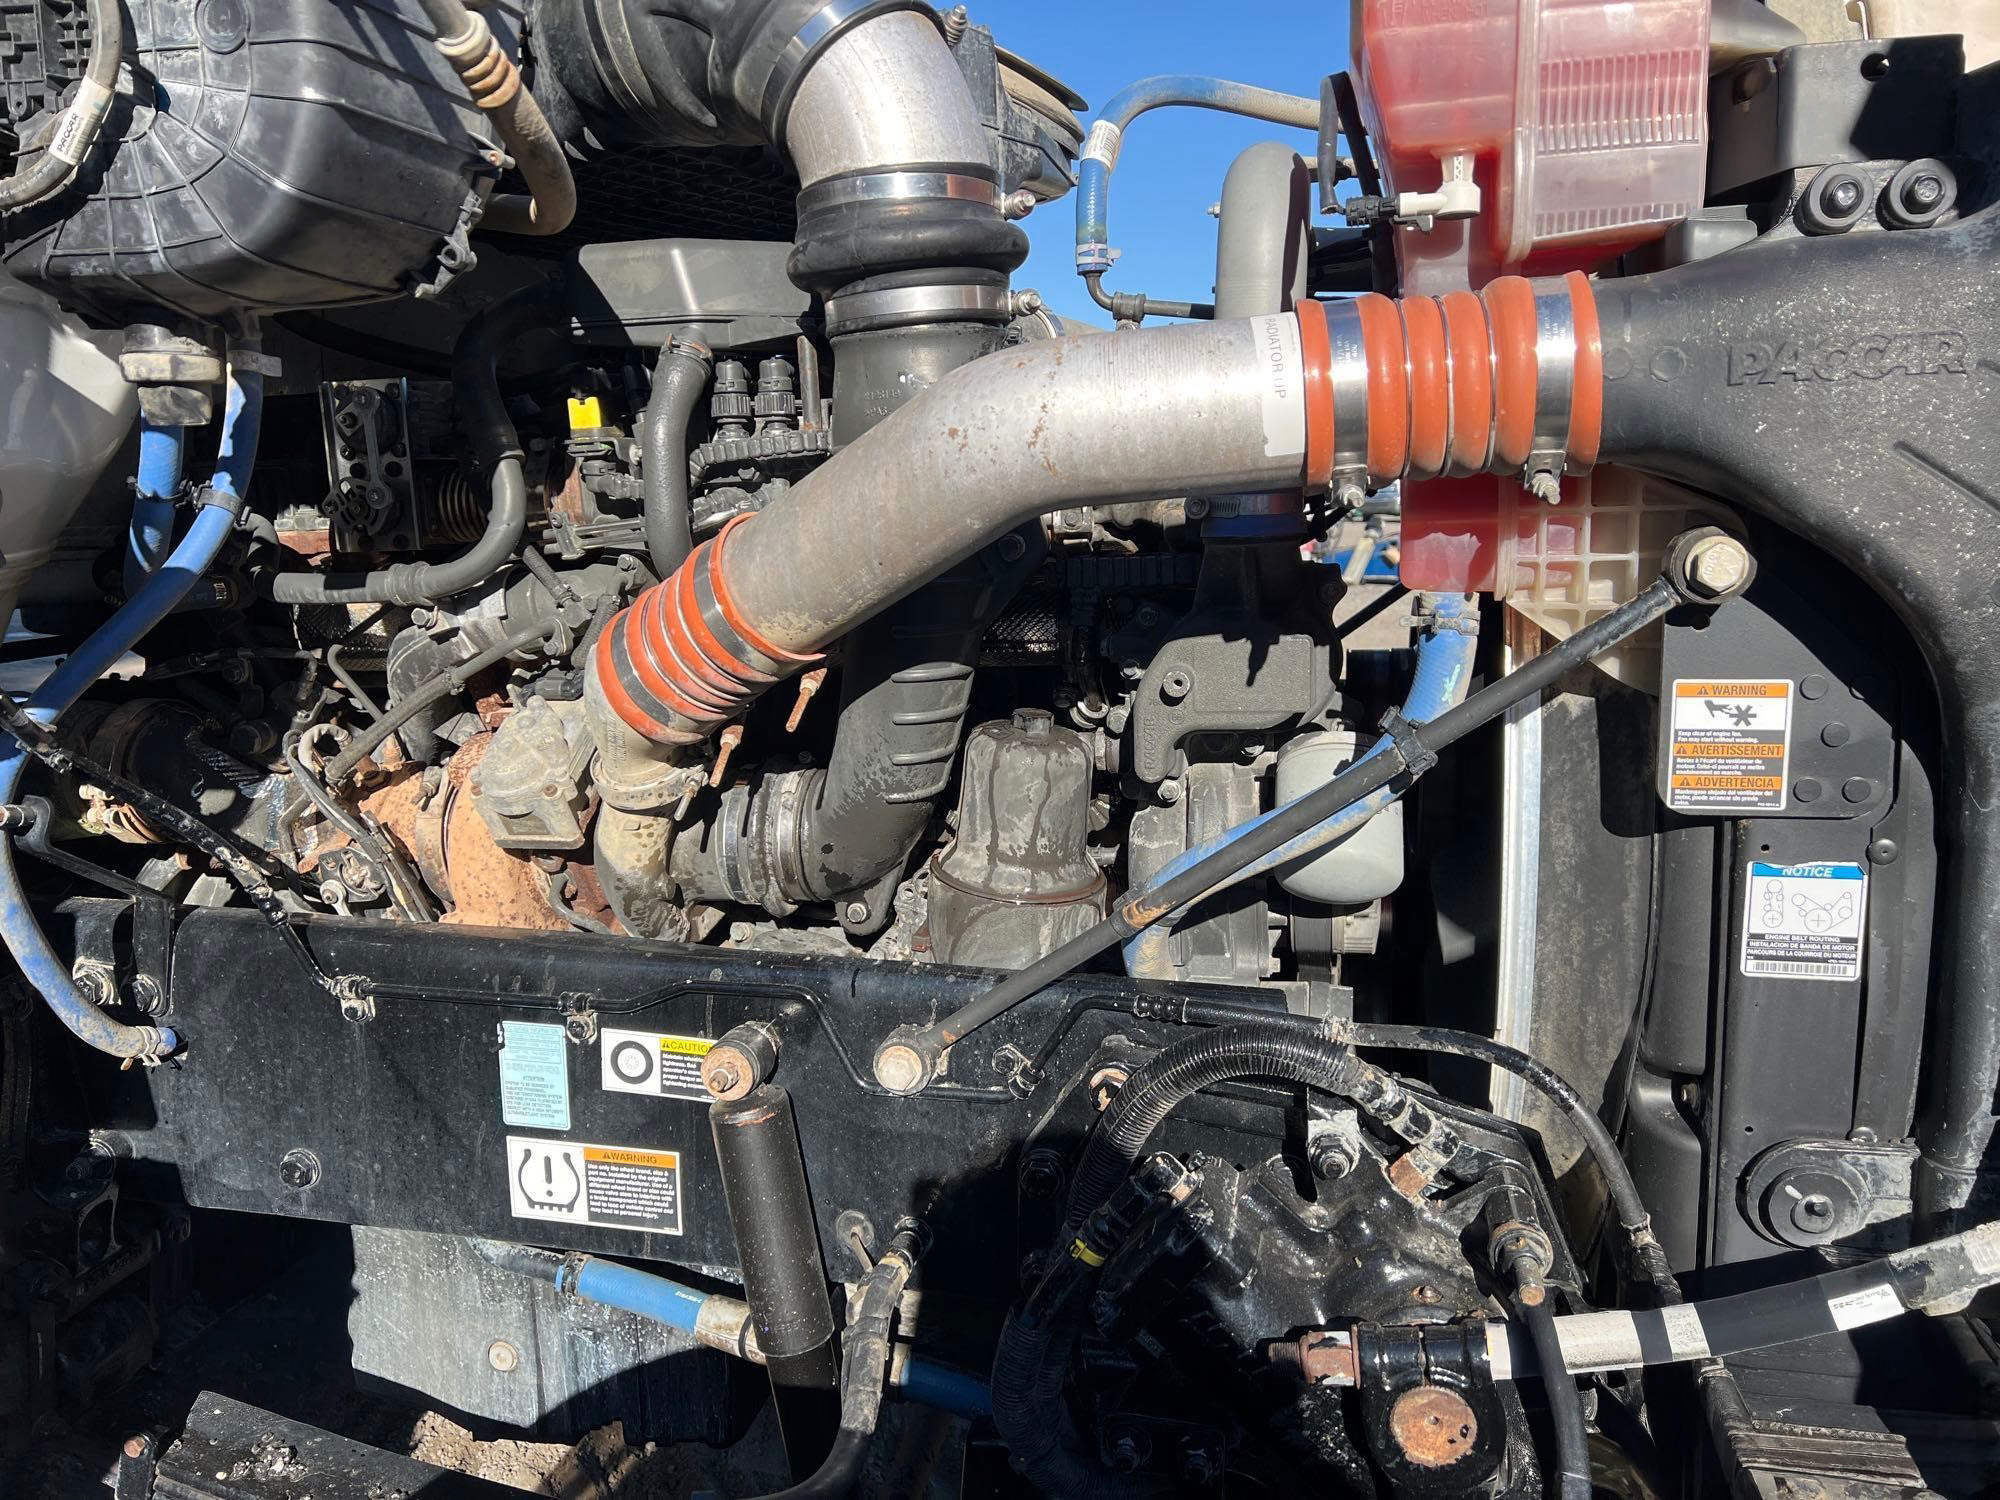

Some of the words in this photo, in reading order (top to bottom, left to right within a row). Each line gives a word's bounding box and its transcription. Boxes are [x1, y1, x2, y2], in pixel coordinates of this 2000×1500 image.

[57, 113, 79, 152] PACCAR
[1265, 318, 1284, 373] RADIATOR
[1727, 332, 1968, 387] PACCAR
[1712, 685, 1767, 695] WARNING
[1692, 745, 1781, 756] AVERTISSEMENT
[1695, 777, 1774, 788] ADVERTENCIA
[1782, 866, 1834, 877] NOTICE
[611, 1152, 657, 1164] WARNING
